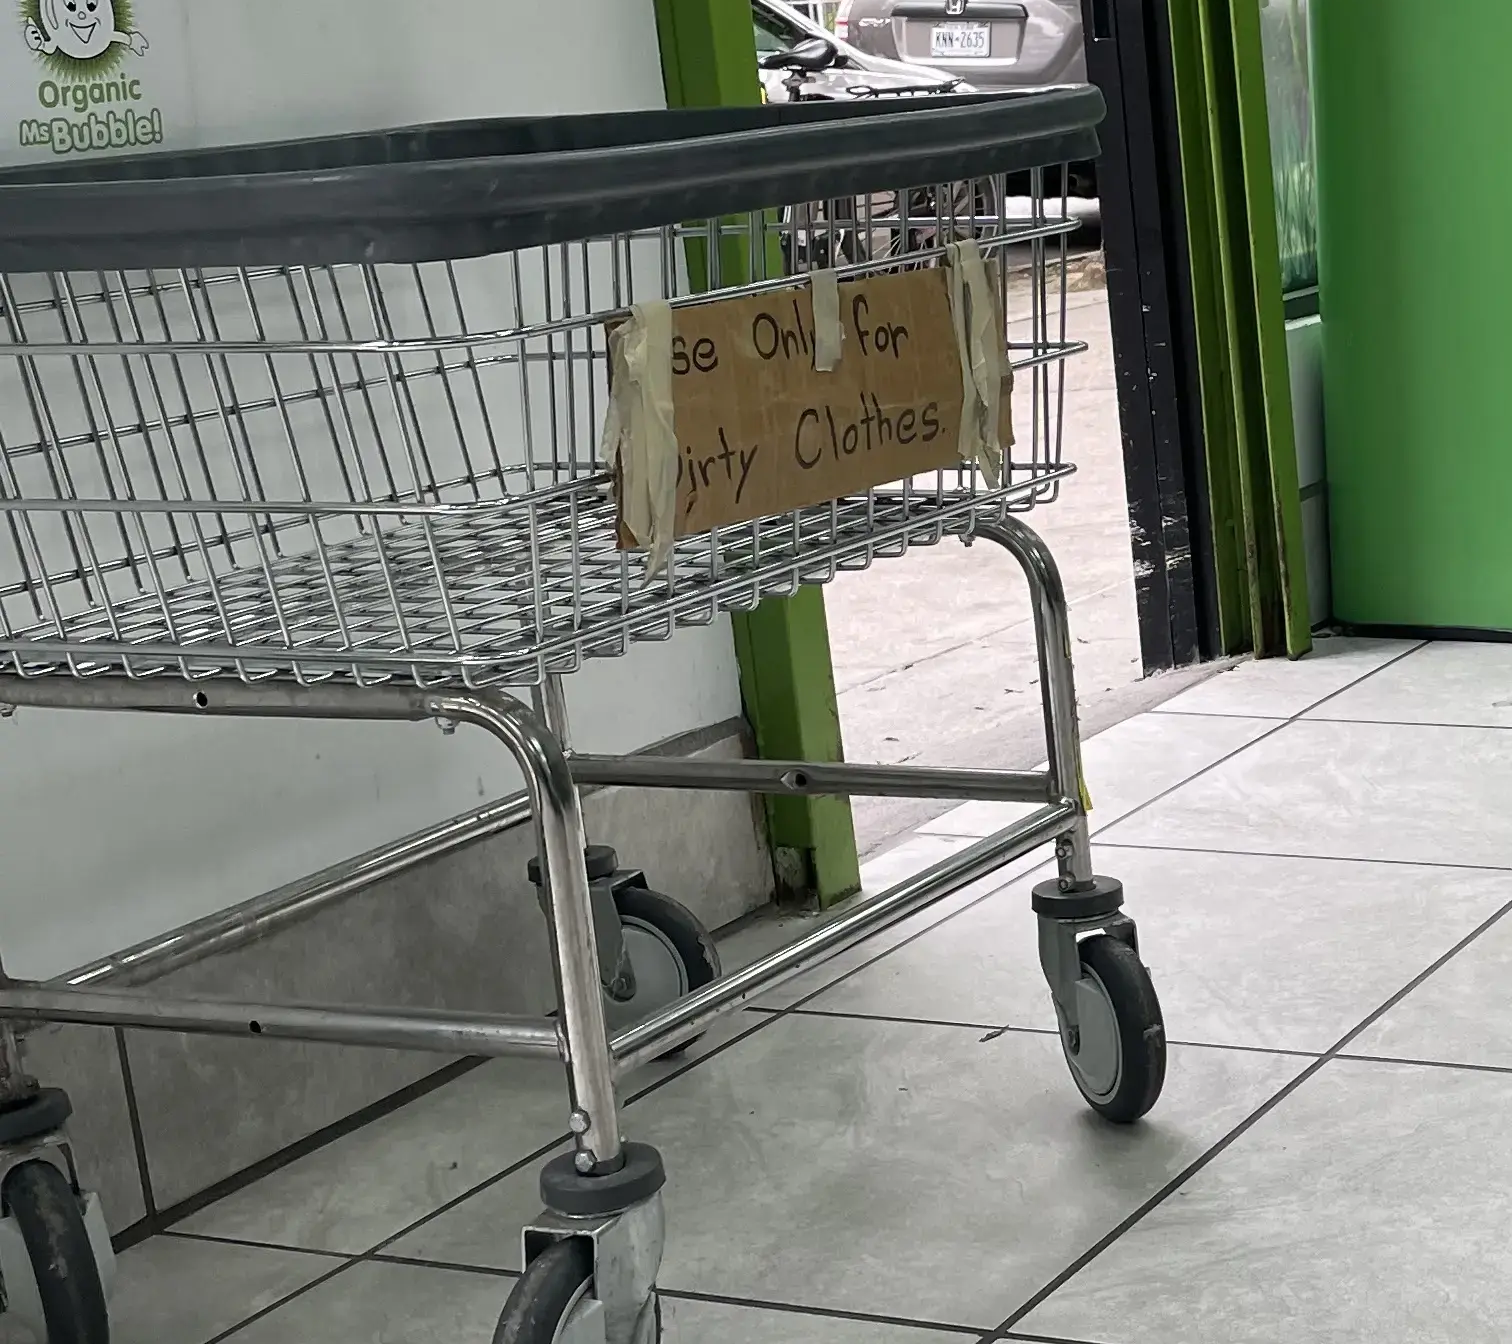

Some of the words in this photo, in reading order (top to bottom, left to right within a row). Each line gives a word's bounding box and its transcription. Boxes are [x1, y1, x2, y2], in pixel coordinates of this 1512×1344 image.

[38, 72, 142, 113] Organic
[20, 119, 51, 146] Ms
[50, 108, 163, 154] Bubble!
[671, 335, 719, 375] se
[852, 293, 910, 359] for
[795, 391, 946, 469] Clothes.
